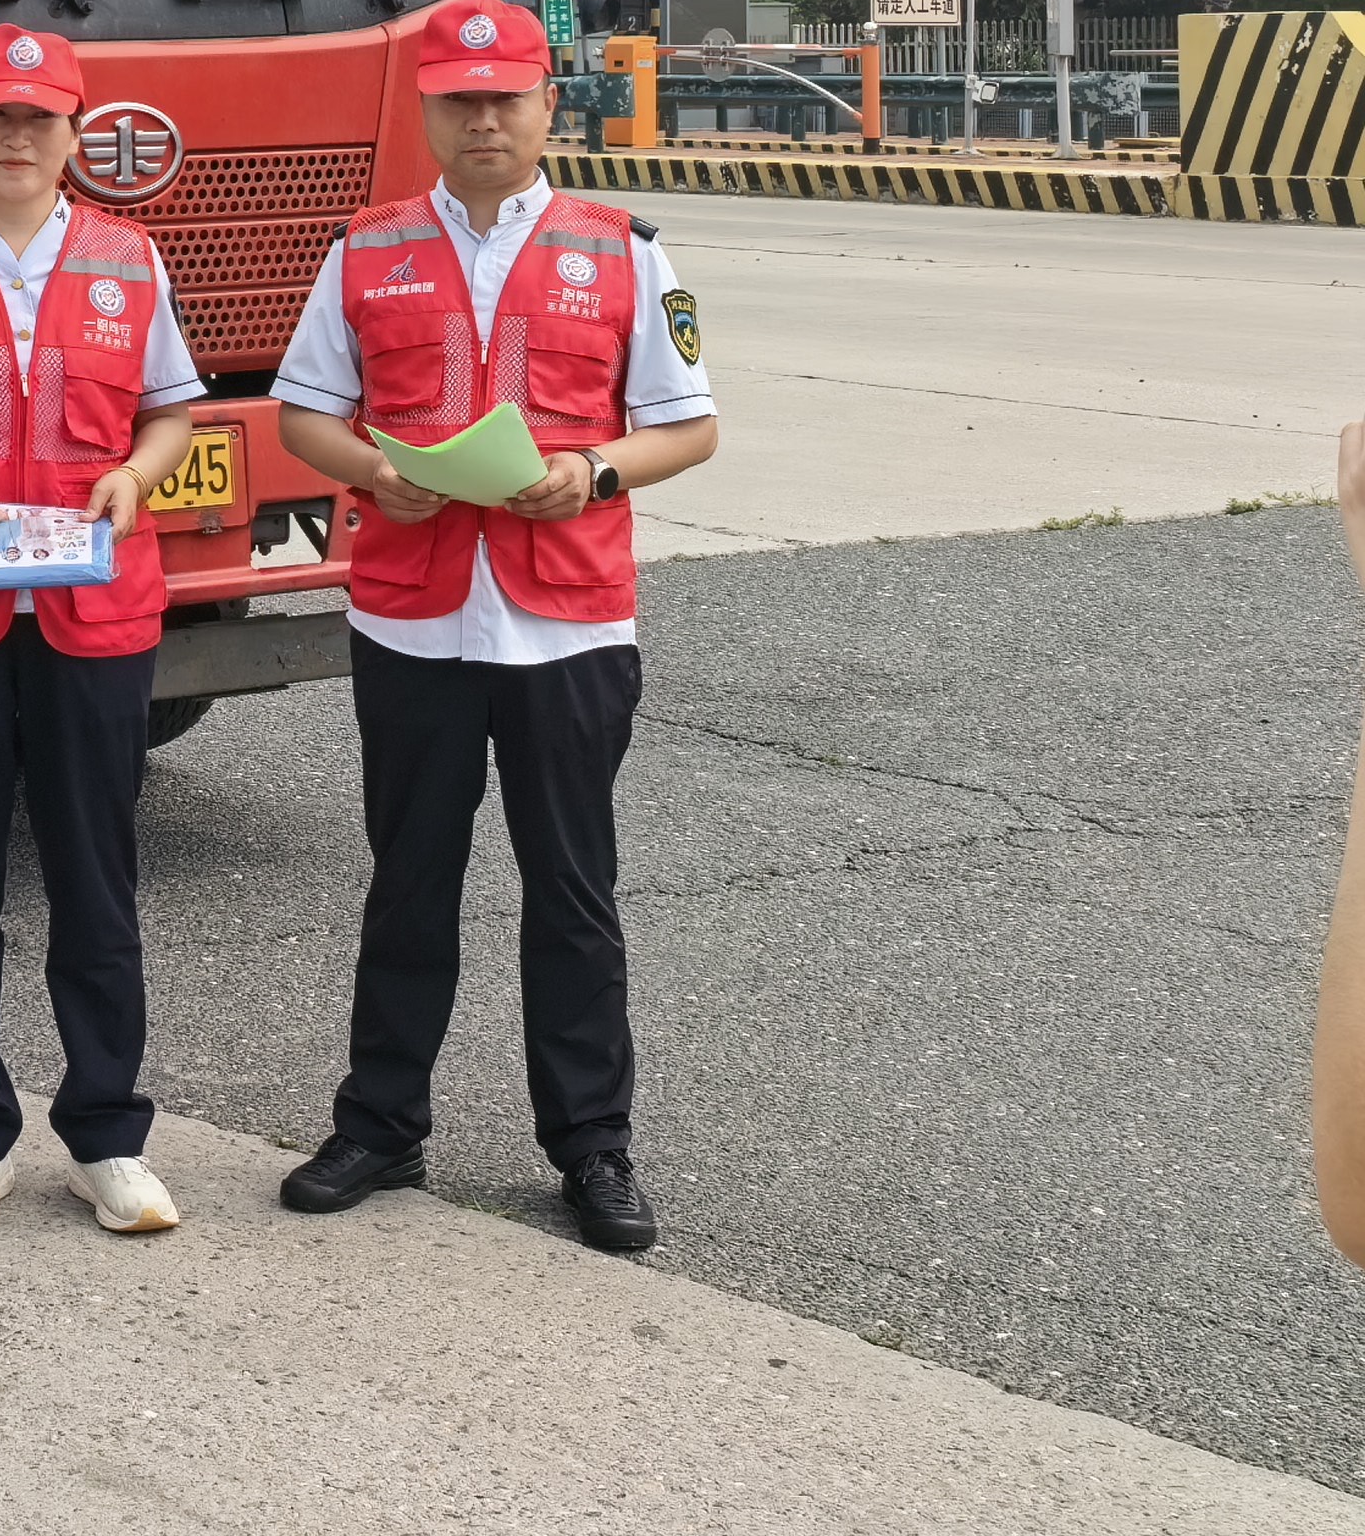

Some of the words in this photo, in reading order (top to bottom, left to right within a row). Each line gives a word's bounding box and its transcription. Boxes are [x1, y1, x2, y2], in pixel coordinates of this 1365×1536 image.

[363, 281, 436, 301] 河北高速集团
